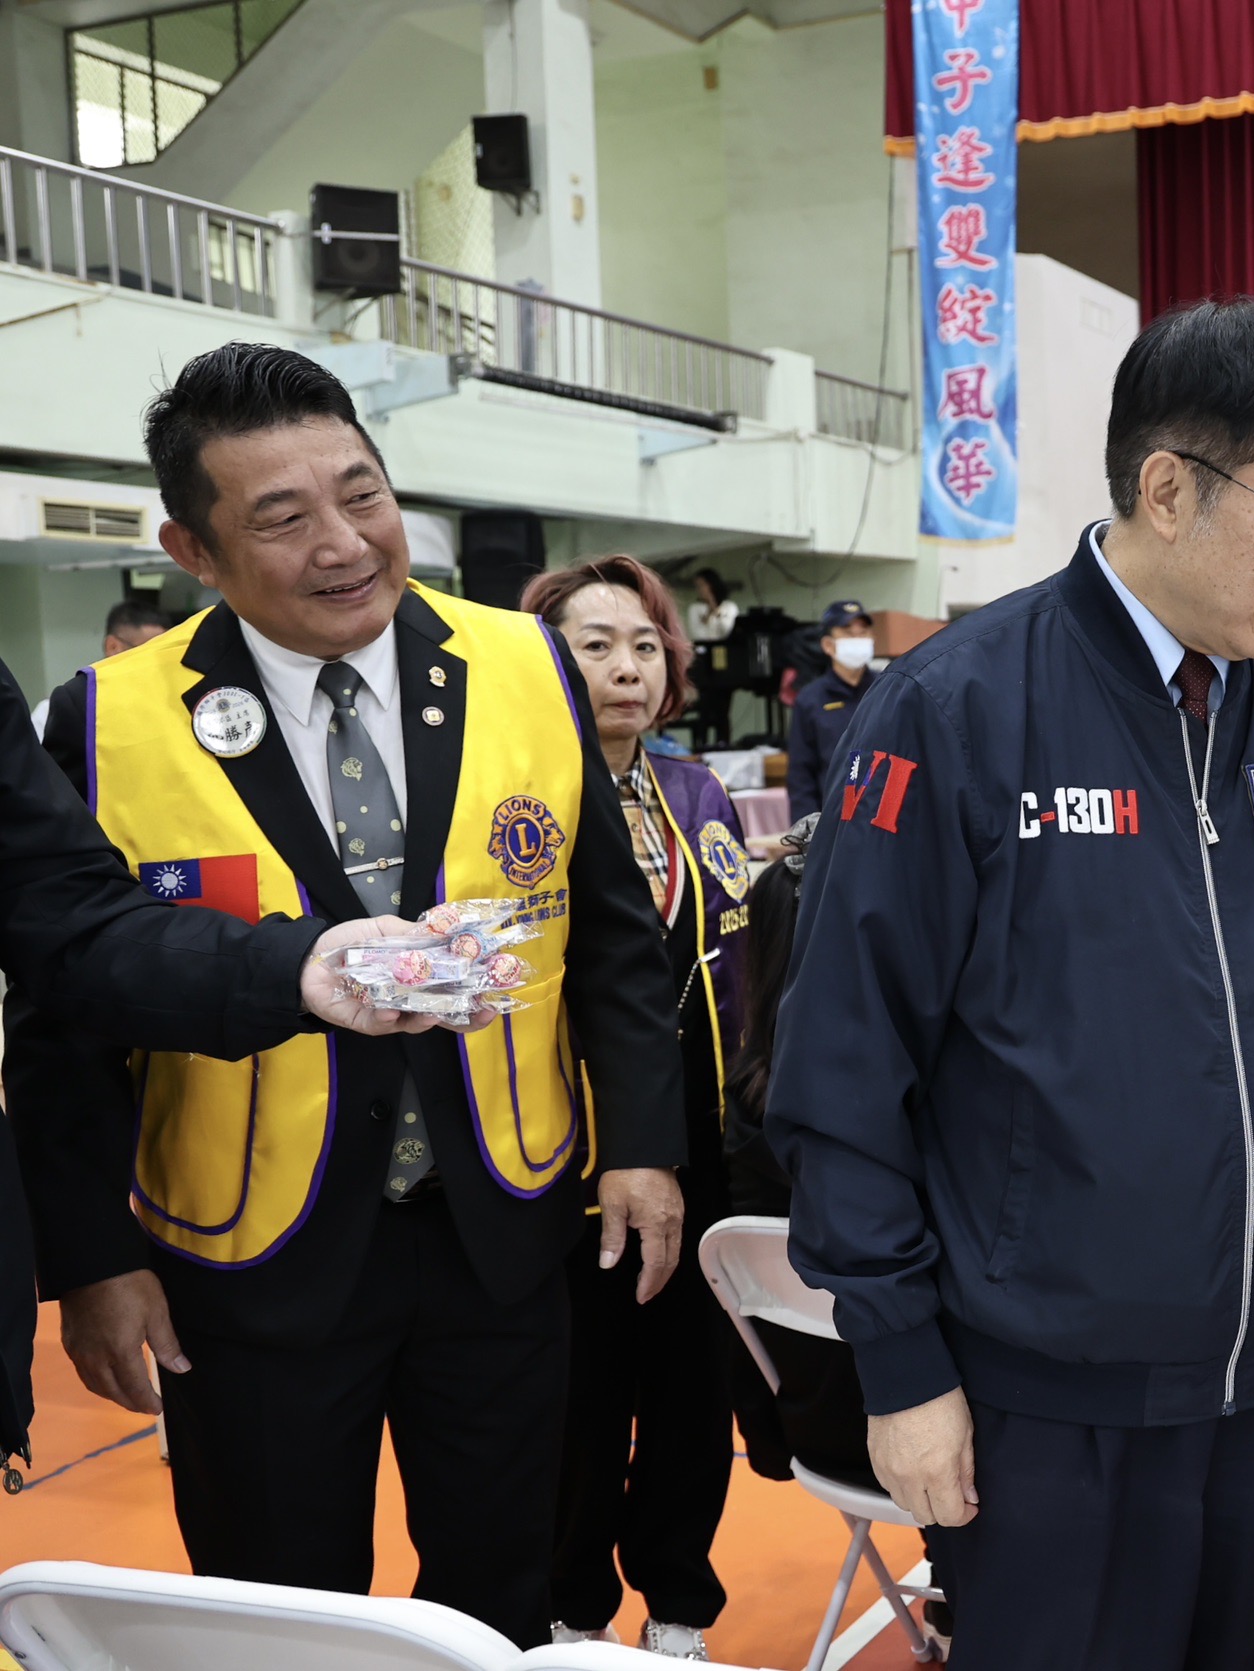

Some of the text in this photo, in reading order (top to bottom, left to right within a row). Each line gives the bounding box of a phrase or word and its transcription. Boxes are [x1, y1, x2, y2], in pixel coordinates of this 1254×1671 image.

[498, 798, 542, 821] LIONS
[1019, 787, 1139, 839] C-130H
[515, 823, 537, 858] L
[551, 902, 567, 918] CLUB
